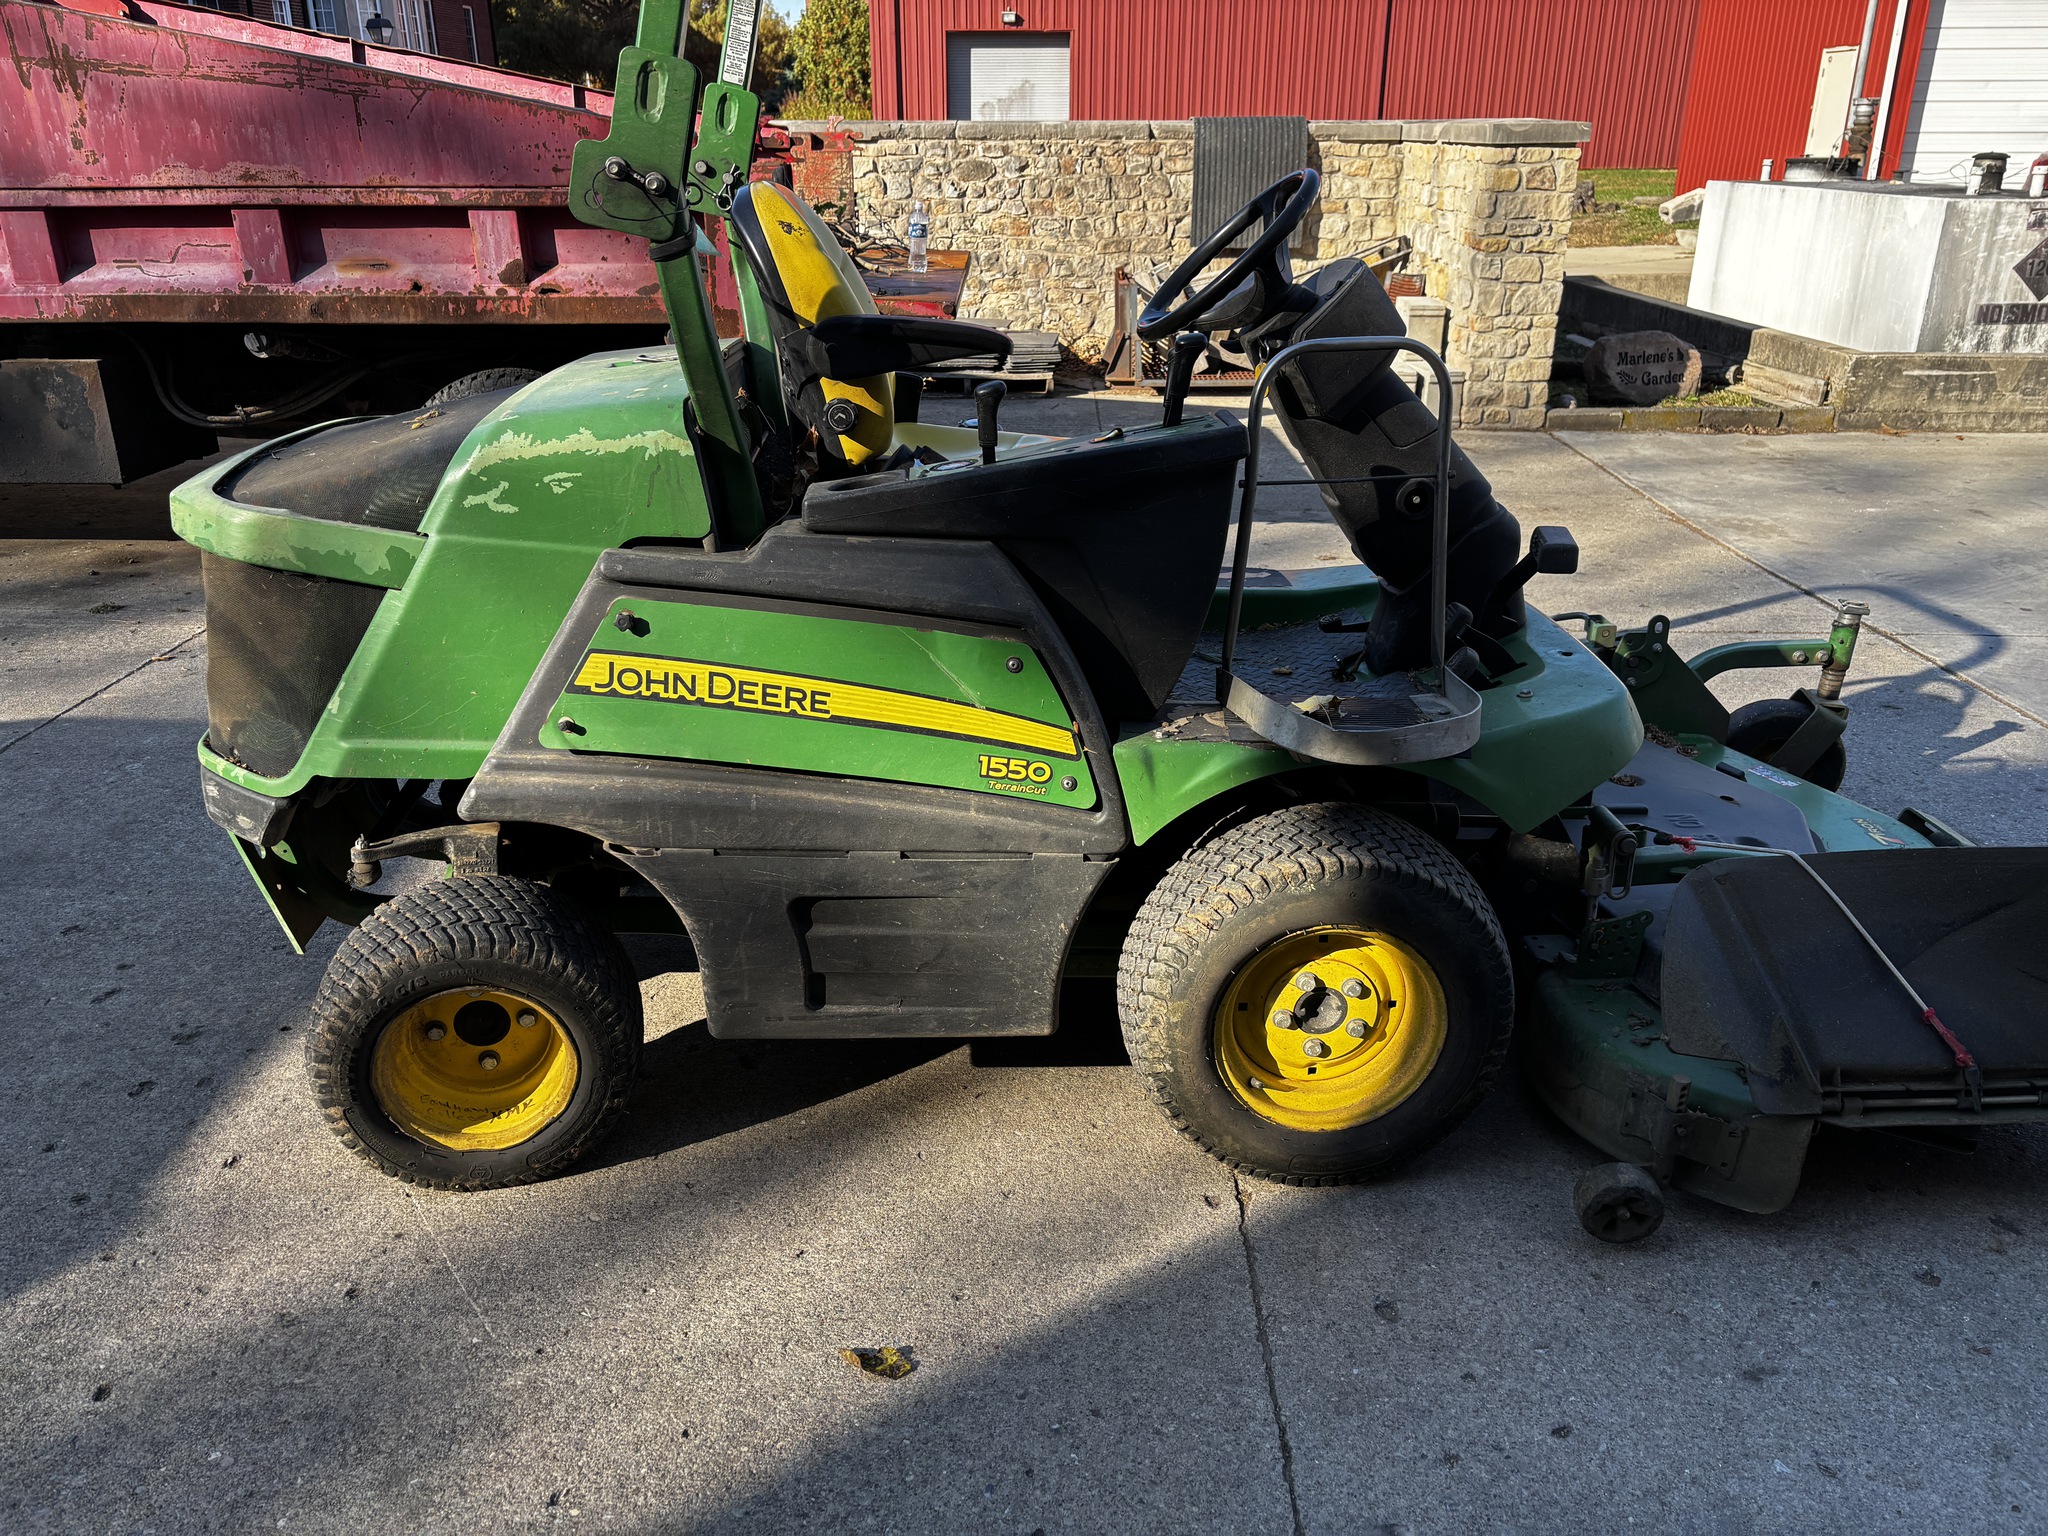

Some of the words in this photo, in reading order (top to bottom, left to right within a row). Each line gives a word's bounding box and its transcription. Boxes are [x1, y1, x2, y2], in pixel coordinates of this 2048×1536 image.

[1976, 304, 2002, 324] NO
[1616, 347, 1674, 366] Marlene's
[1641, 370, 1684, 386] Garden
[594, 661, 697, 698] JOHN
[708, 671, 831, 715] DEERE
[979, 755, 1053, 784] 1550
[988, 780, 1047, 796] TerrainCut
